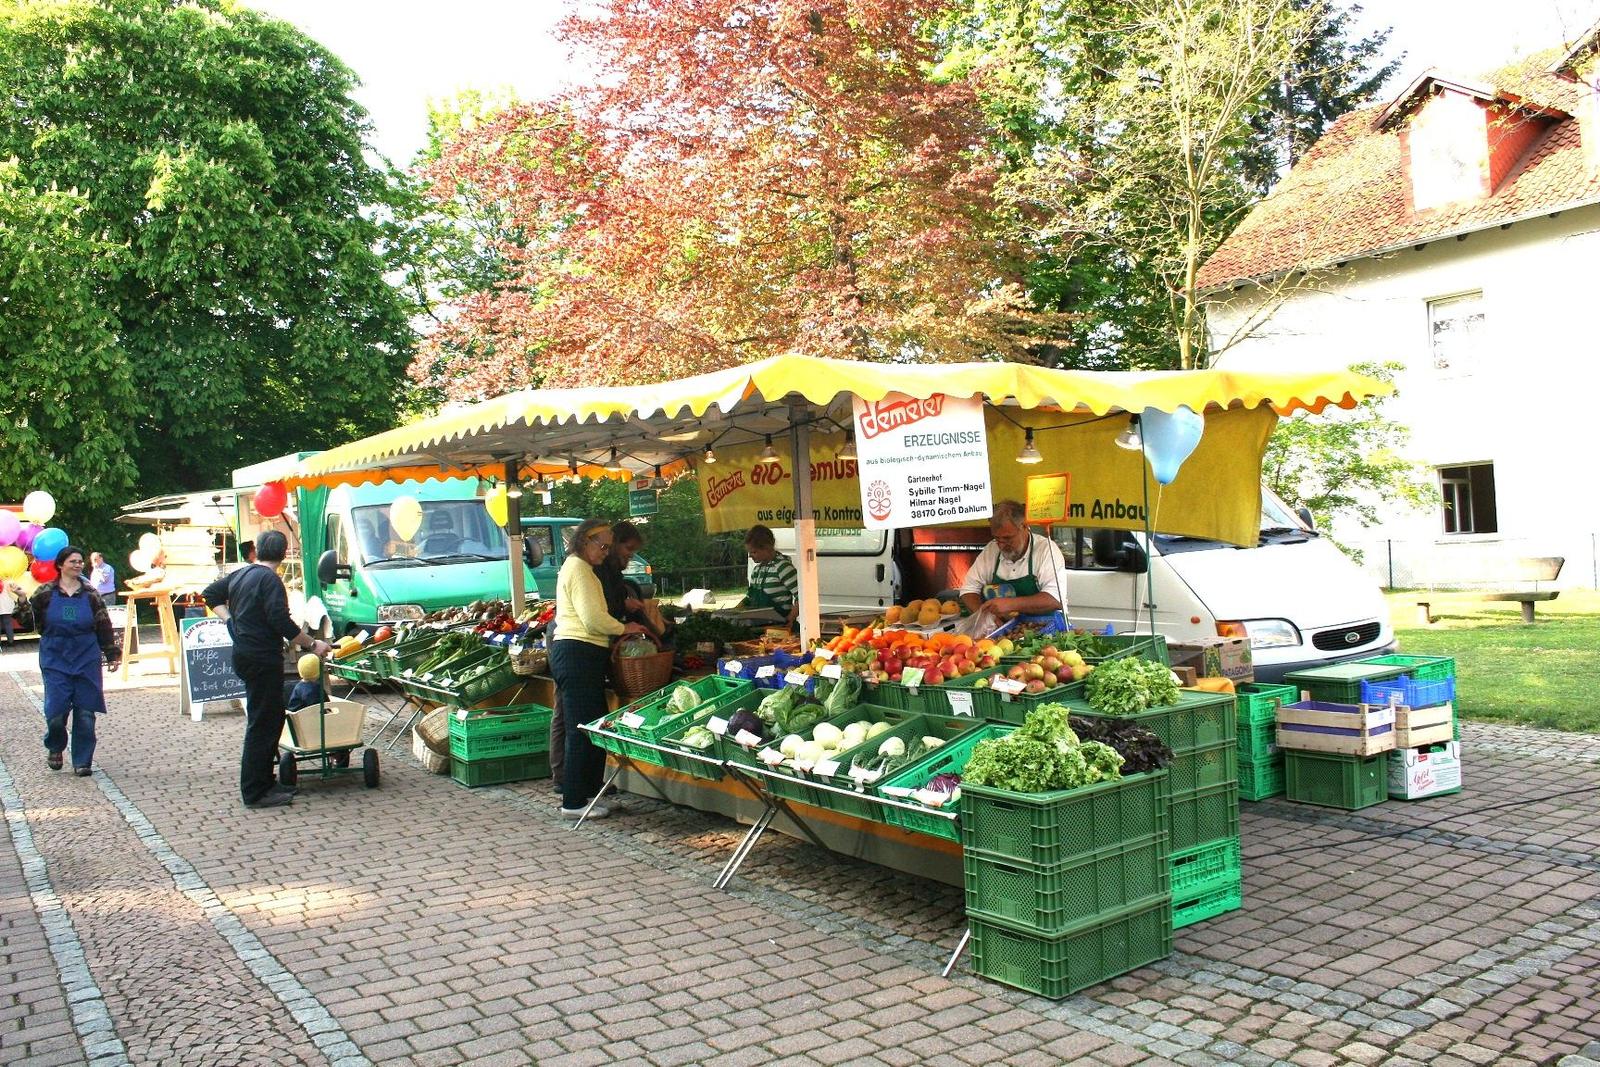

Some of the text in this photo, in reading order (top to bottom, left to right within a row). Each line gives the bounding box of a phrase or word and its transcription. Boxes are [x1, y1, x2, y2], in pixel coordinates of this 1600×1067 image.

[904, 431, 981, 448] ERZEUGNISSE
[908, 482, 986, 497] Sybille Timm-Nagel
[909, 495, 961, 508] Hilmar Nagel
[757, 509, 774, 521] aus
[825, 506, 863, 520] Kontrol
[911, 504, 988, 519] 38170 Groß Dahlum
[1090, 498, 1147, 521] Anbau
